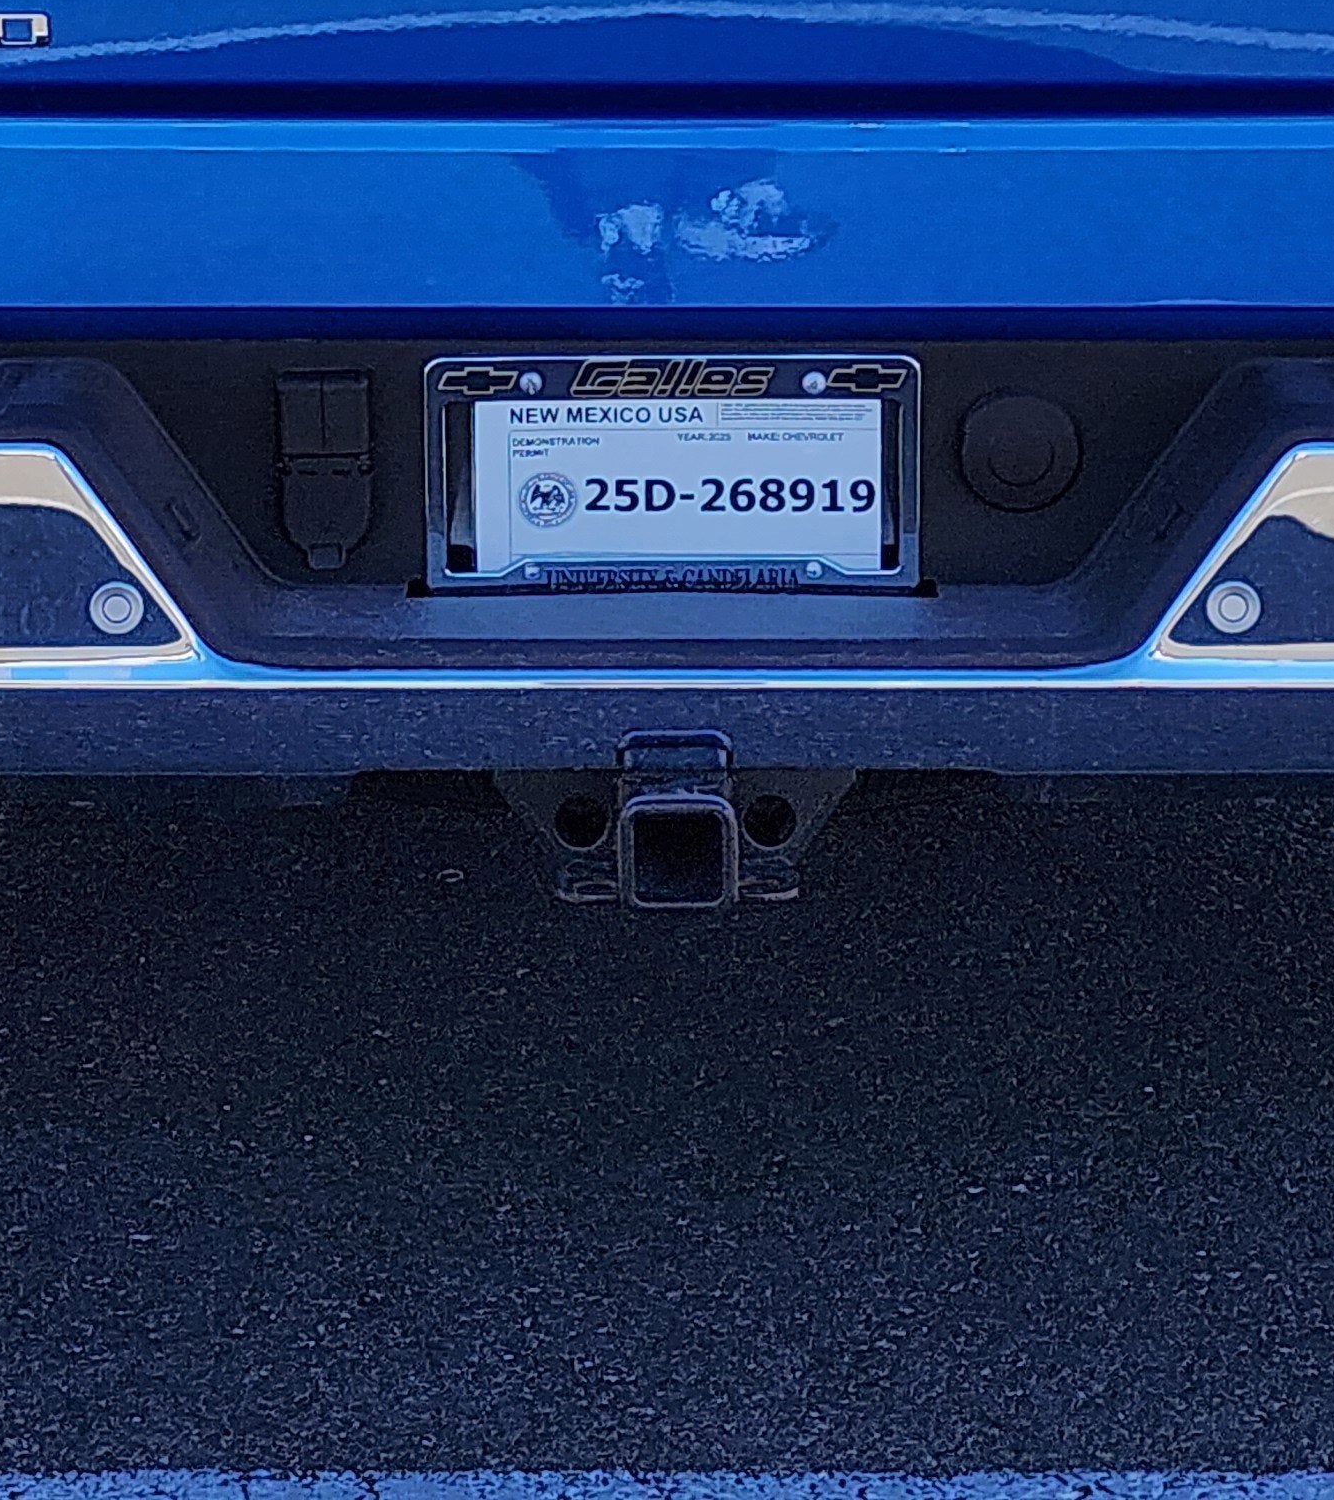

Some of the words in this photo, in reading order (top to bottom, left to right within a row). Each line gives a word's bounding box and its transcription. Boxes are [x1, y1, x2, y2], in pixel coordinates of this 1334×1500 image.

[569, 358, 776, 398] Galles
[509, 406, 560, 424] NEW
[566, 406, 651, 424] MEXICO
[658, 406, 704, 424] USA
[511, 436, 601, 448] DEMONSTRATION
[583, 477, 877, 514] 25D-268919
